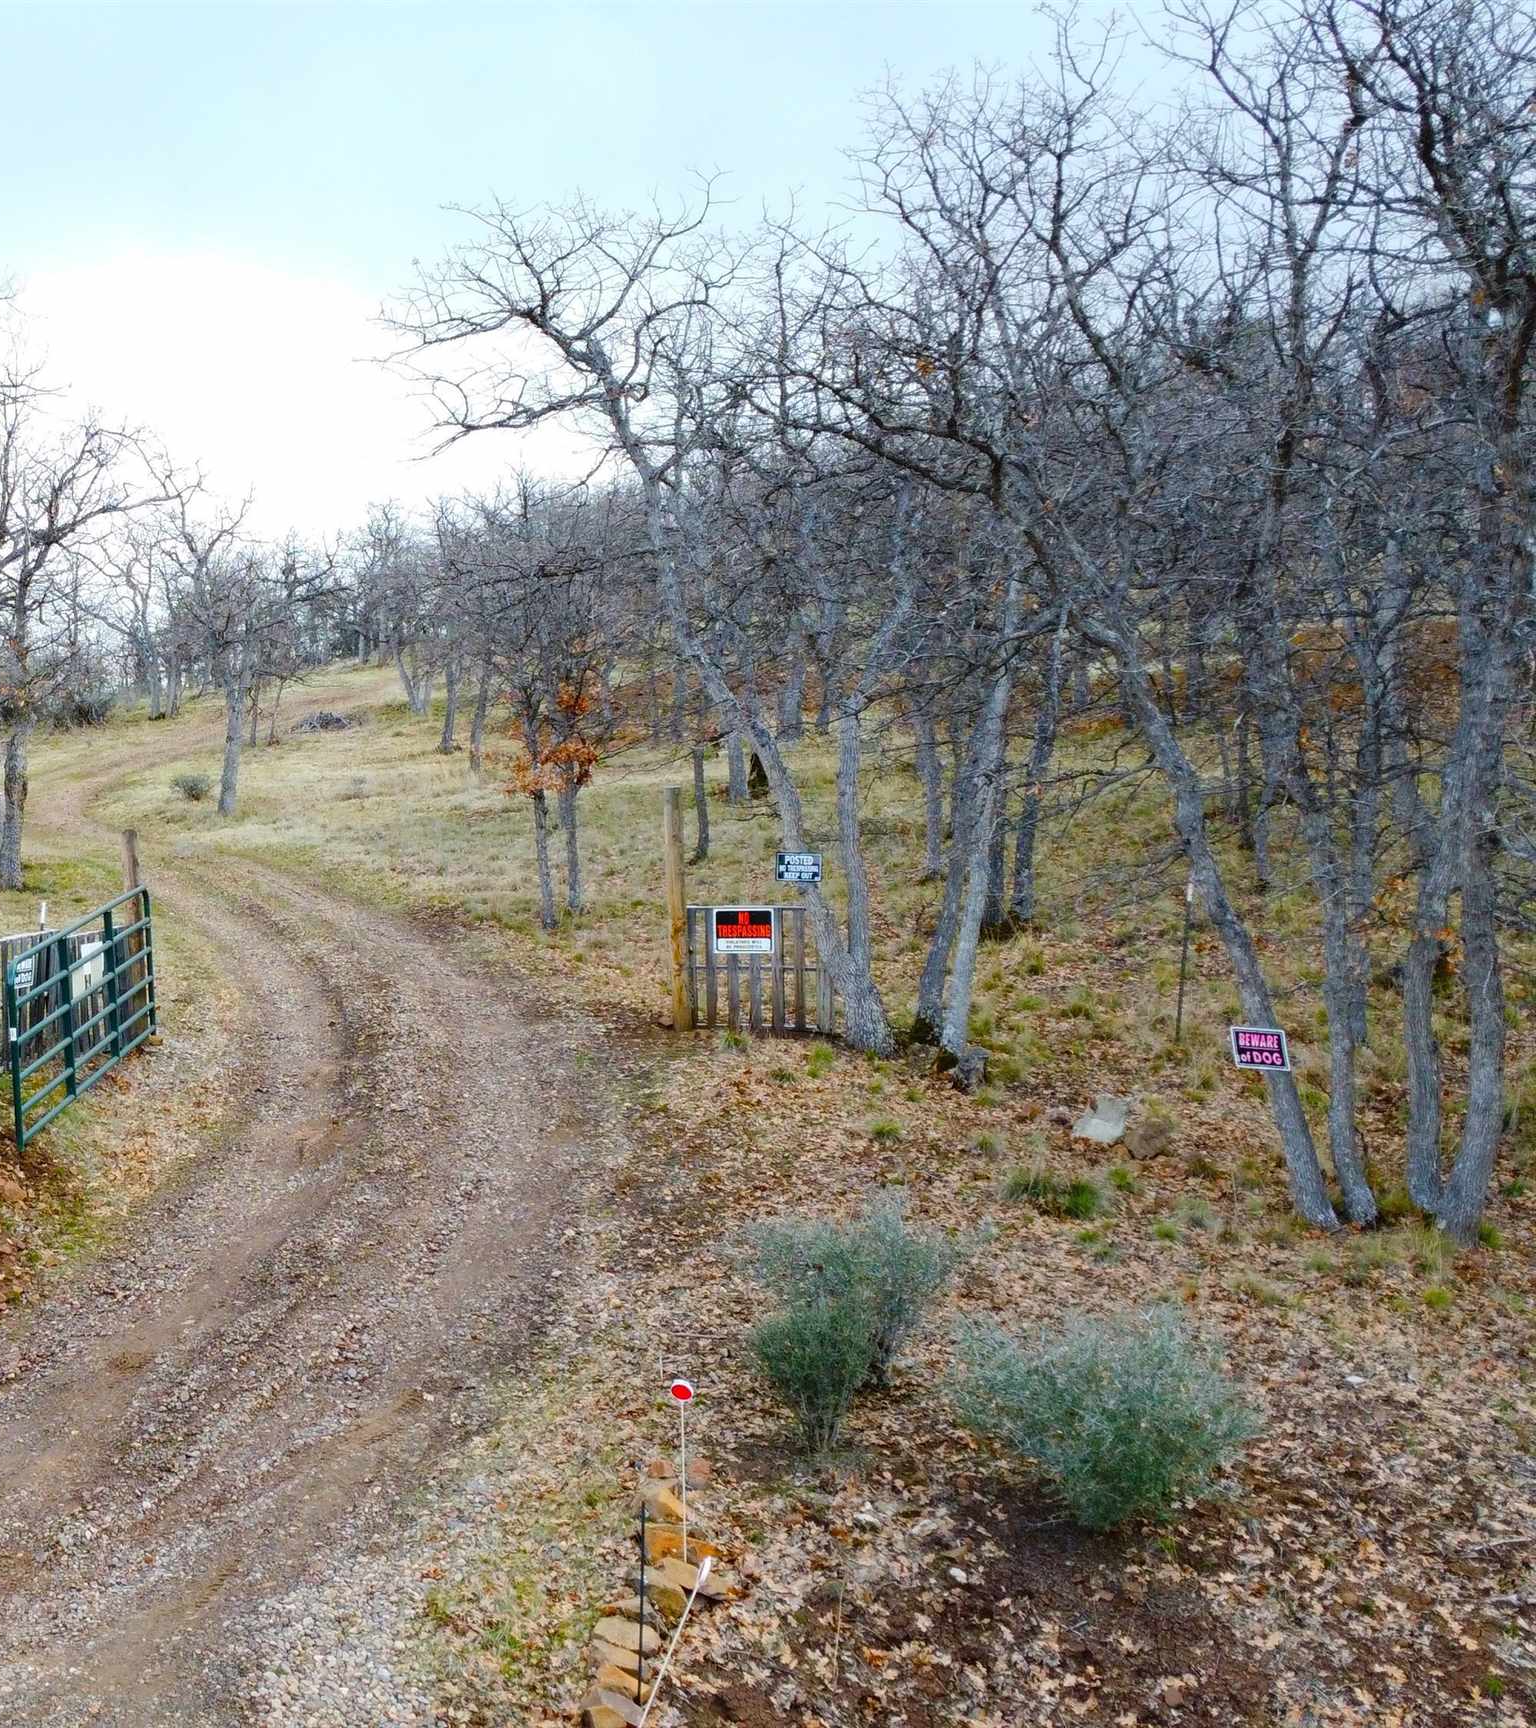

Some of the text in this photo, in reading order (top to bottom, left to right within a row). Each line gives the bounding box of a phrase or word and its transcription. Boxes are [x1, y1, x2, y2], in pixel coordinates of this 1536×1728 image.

[784, 855, 814, 865] POSTED
[738, 911, 750, 924] NO
[717, 924, 771, 937] TRESPASSING
[1238, 1033, 1279, 1048] BEWARE
[1240, 1051, 1282, 1065] of DOG
